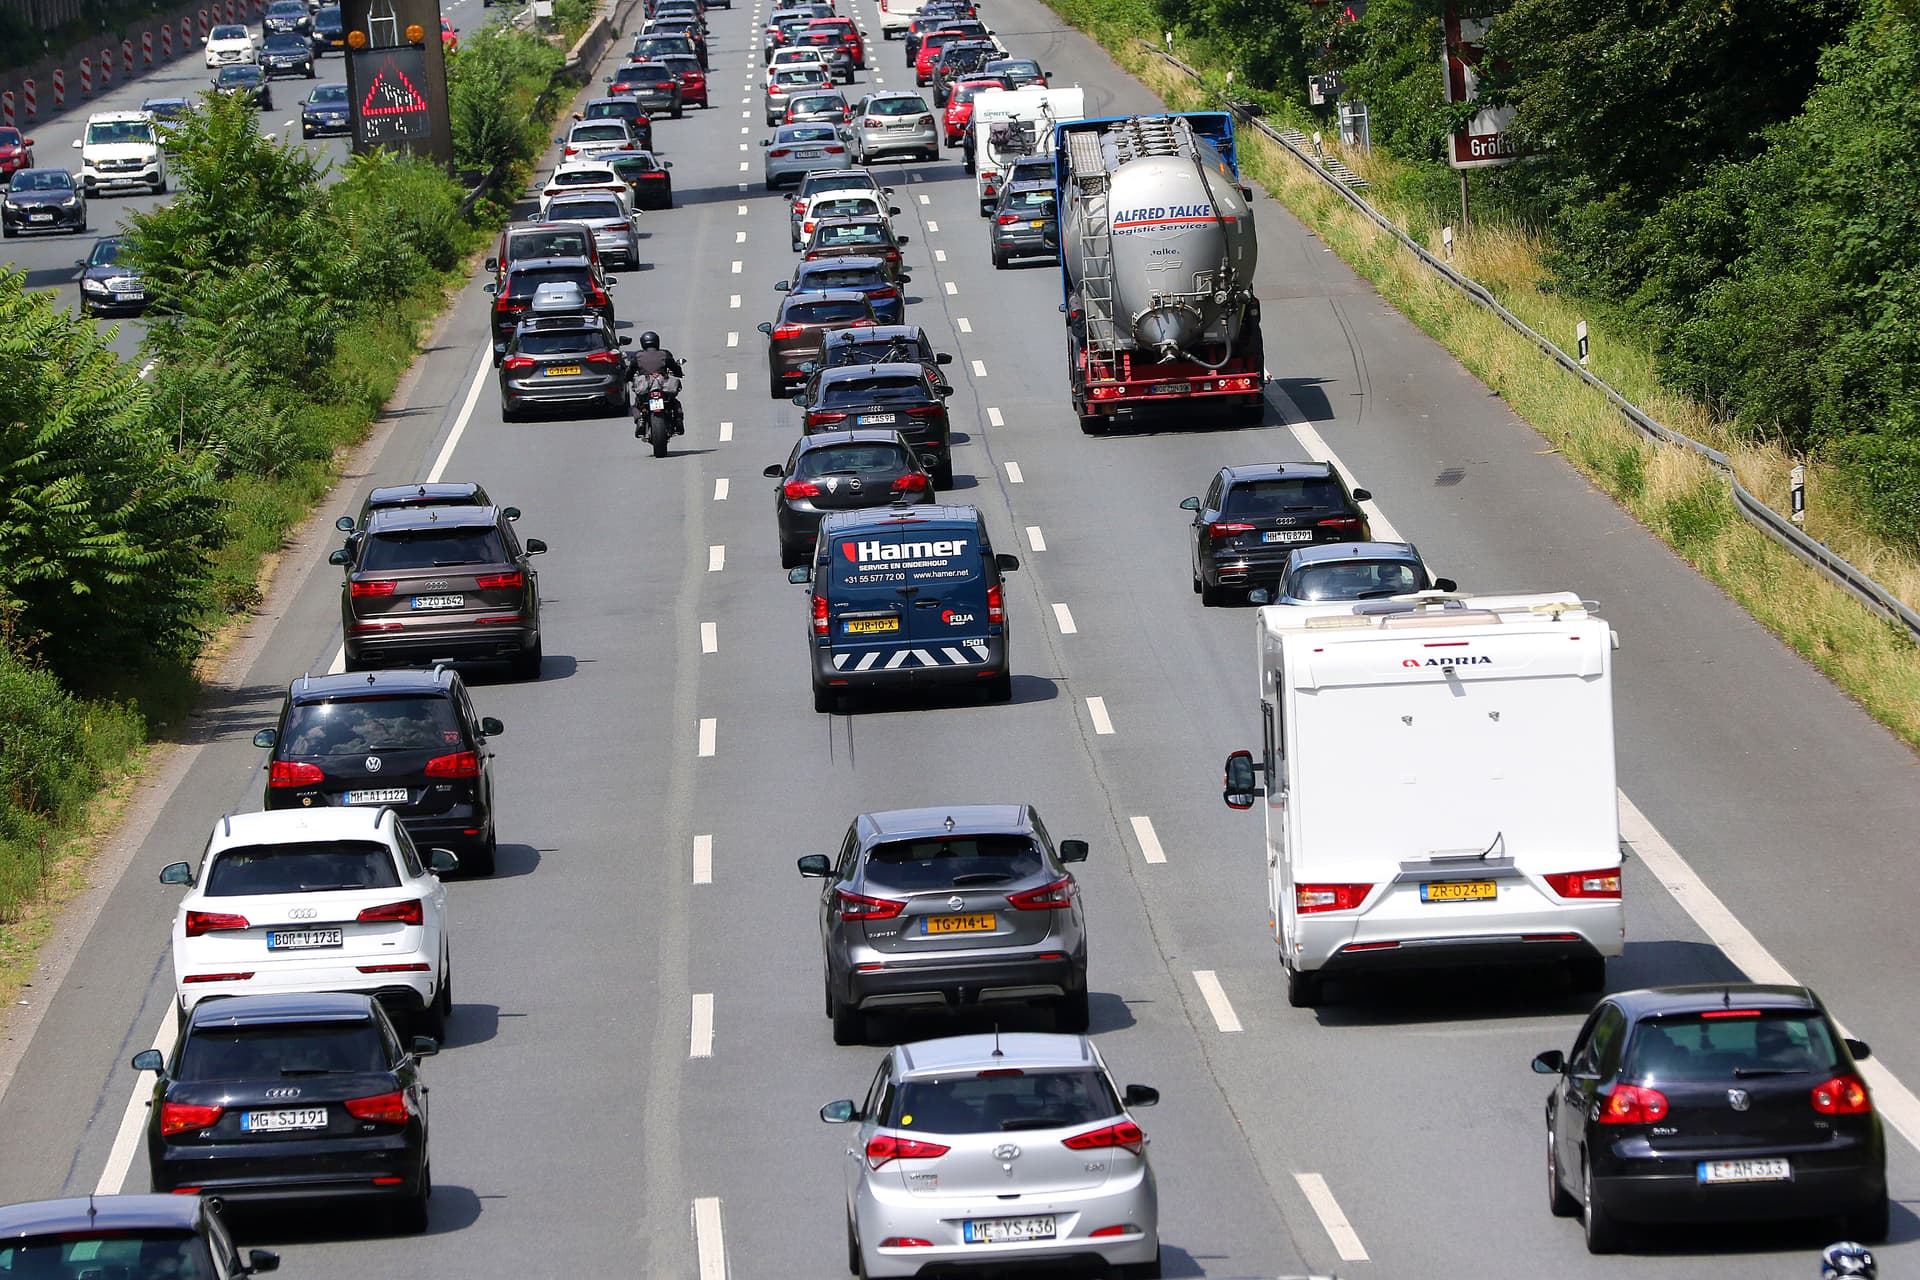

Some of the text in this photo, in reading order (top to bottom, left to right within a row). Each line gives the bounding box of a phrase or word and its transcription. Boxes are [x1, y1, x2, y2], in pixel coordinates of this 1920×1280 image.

[1114, 204, 1210, 223] ALFRED TALKE
[1112, 223, 1208, 236] Logistic Services
[858, 539, 968, 562] Hamer
[859, 563, 888, 572] SERVICE
[902, 560, 948, 568] ONDERHOUD
[870, 574, 884, 582] 577
[885, 573, 894, 581] 72
[913, 569, 969, 579] www.hamer.net
[853, 620, 894, 631] VJR-10-X
[962, 639, 984, 647] 1501
[1425, 656, 1492, 667] ADRIA
[350, 791, 363, 803] MH
[382, 789, 406, 801] 1122
[1432, 883, 1492, 897] ZR-024-P
[933, 917, 988, 931] TG-714-L
[275, 933, 296, 946] BOR
[313, 930, 340, 944] 173E
[250, 1110, 326, 1128] MG SJ 191
[973, 1219, 1053, 1238] ME YS 436
